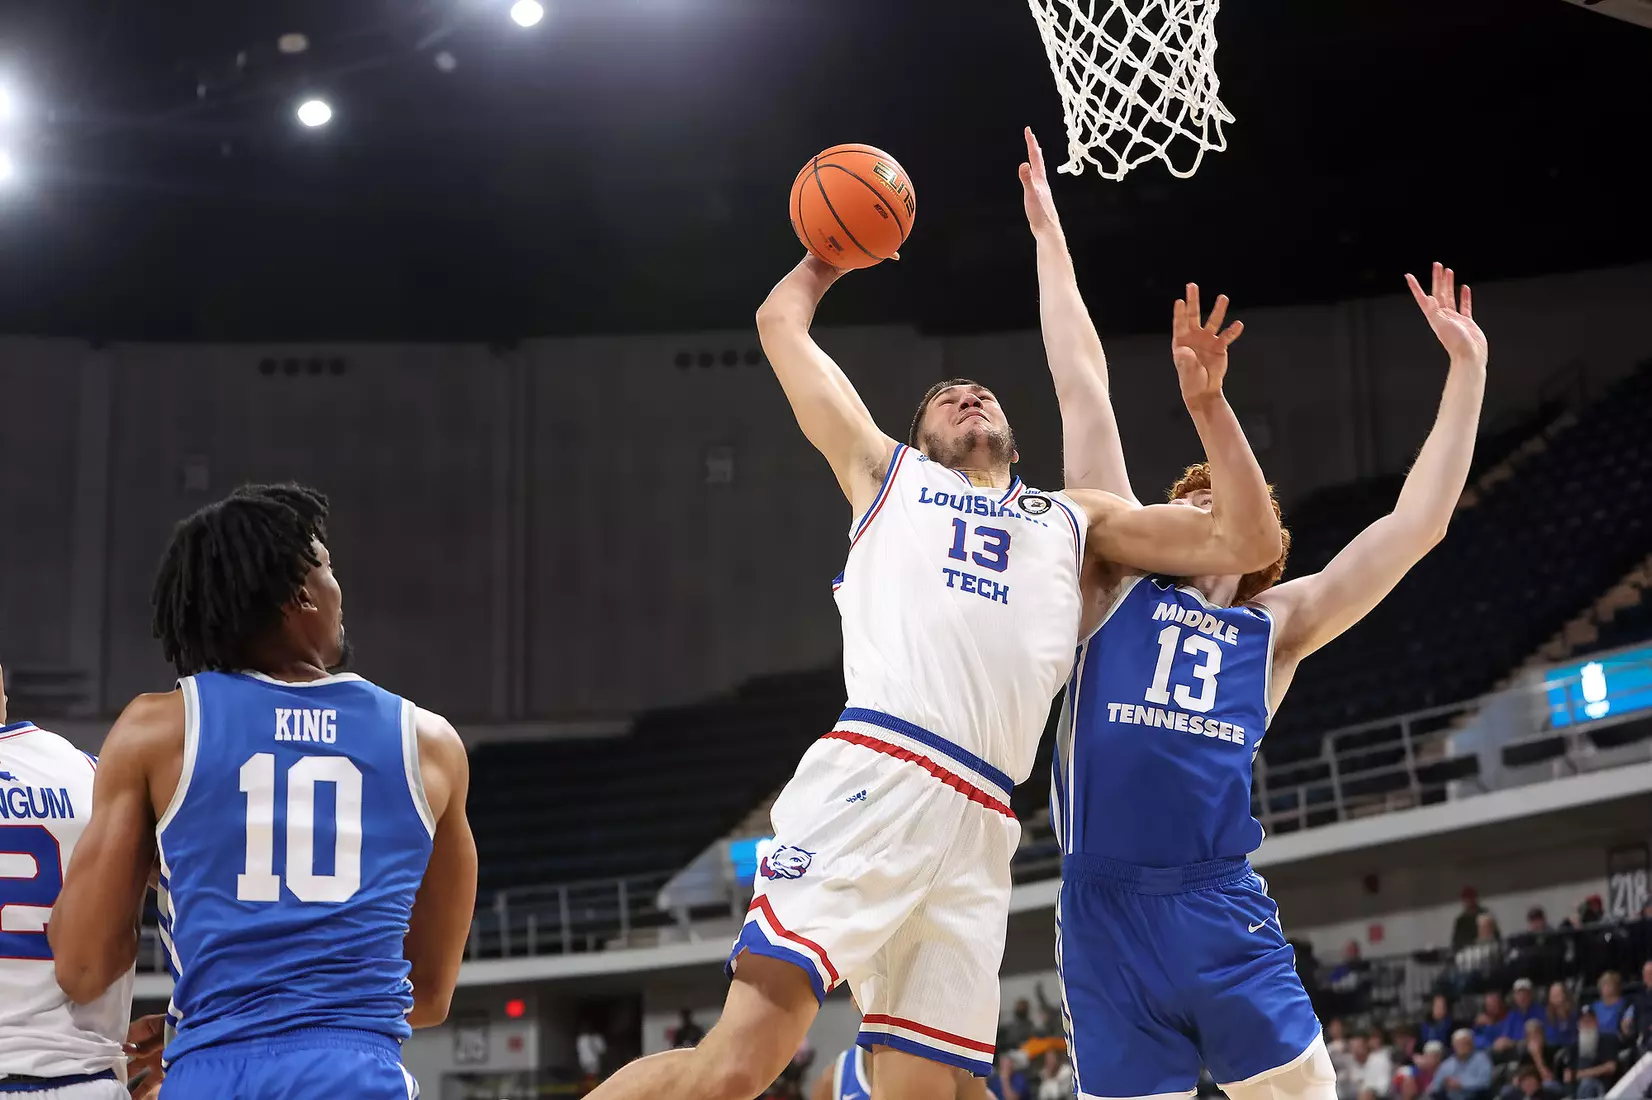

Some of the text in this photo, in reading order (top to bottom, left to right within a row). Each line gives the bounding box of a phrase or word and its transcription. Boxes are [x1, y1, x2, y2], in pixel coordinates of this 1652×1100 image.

[918, 487, 1048, 527] LOUISIA
[948, 517, 1011, 573] 13
[942, 567, 1009, 605] TECH
[1151, 602, 1240, 646] MIDDLE
[1144, 624, 1223, 714] 13
[274, 708, 337, 744] KING
[1107, 702, 1246, 746] TENNESSEE
[237, 752, 363, 902] 10
